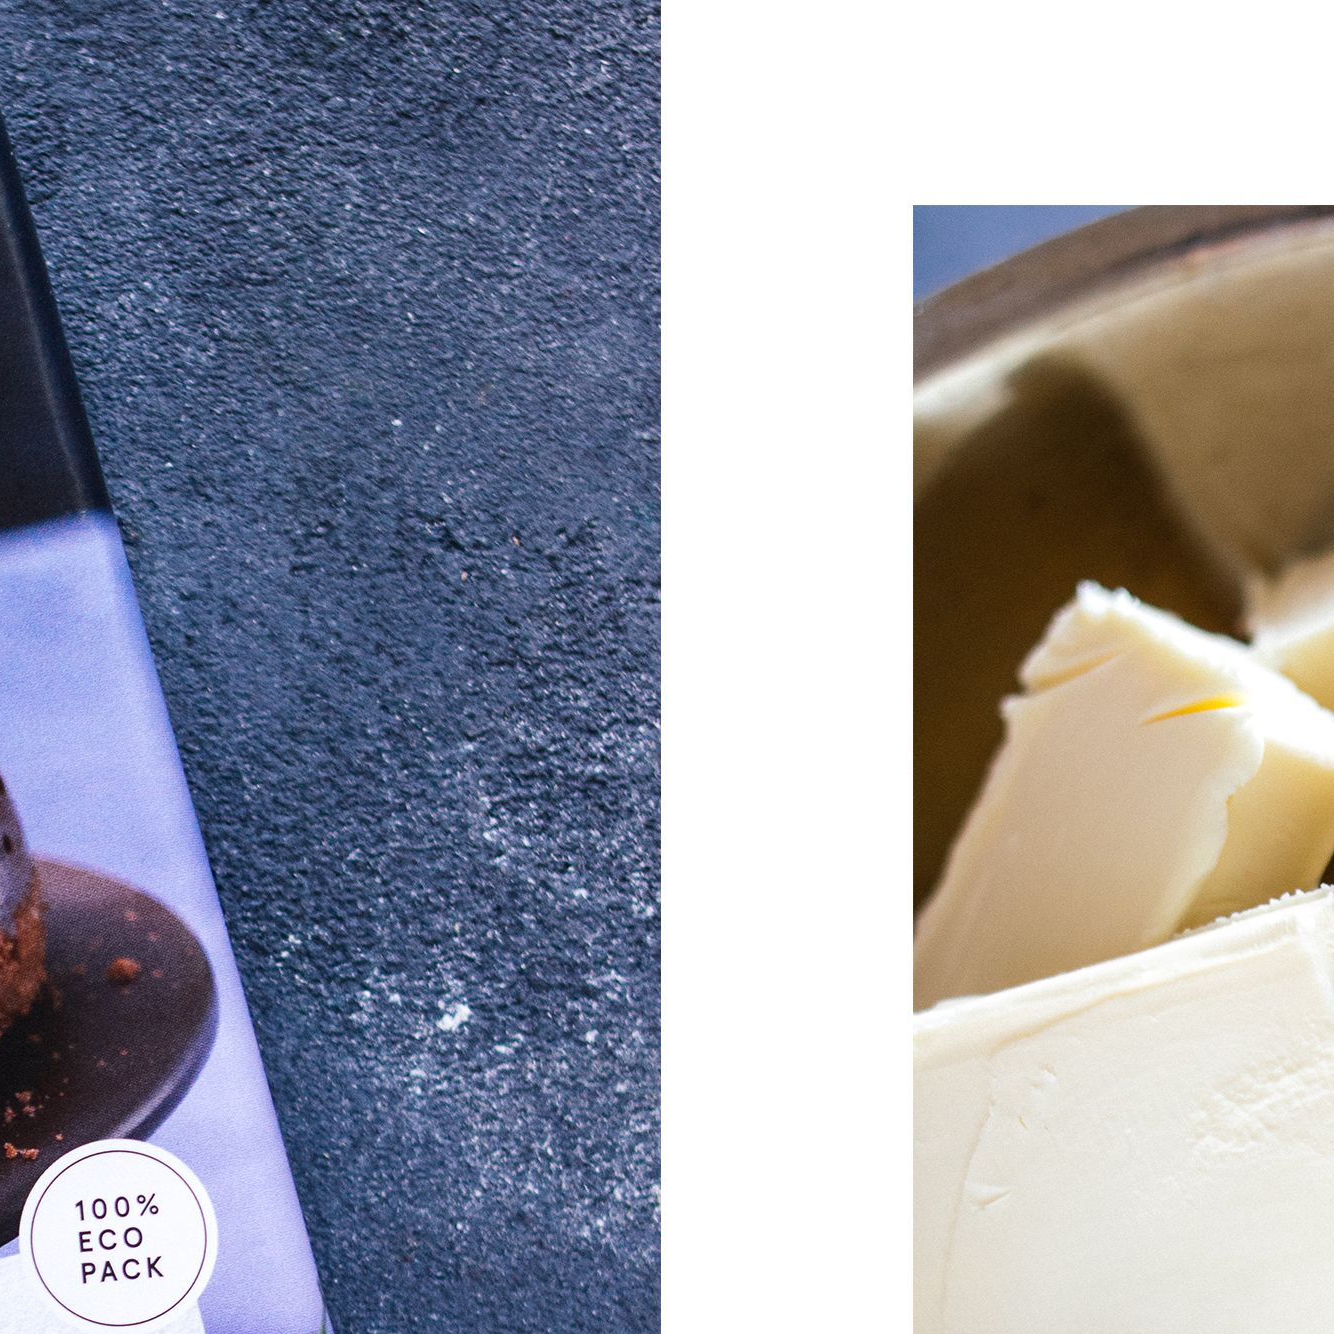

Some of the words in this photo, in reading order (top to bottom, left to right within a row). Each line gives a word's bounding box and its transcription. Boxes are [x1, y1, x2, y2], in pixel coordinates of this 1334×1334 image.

[76, 1194, 158, 1220] 100%
[79, 1227, 142, 1252] ECO
[82, 1256, 163, 1283] PACK
